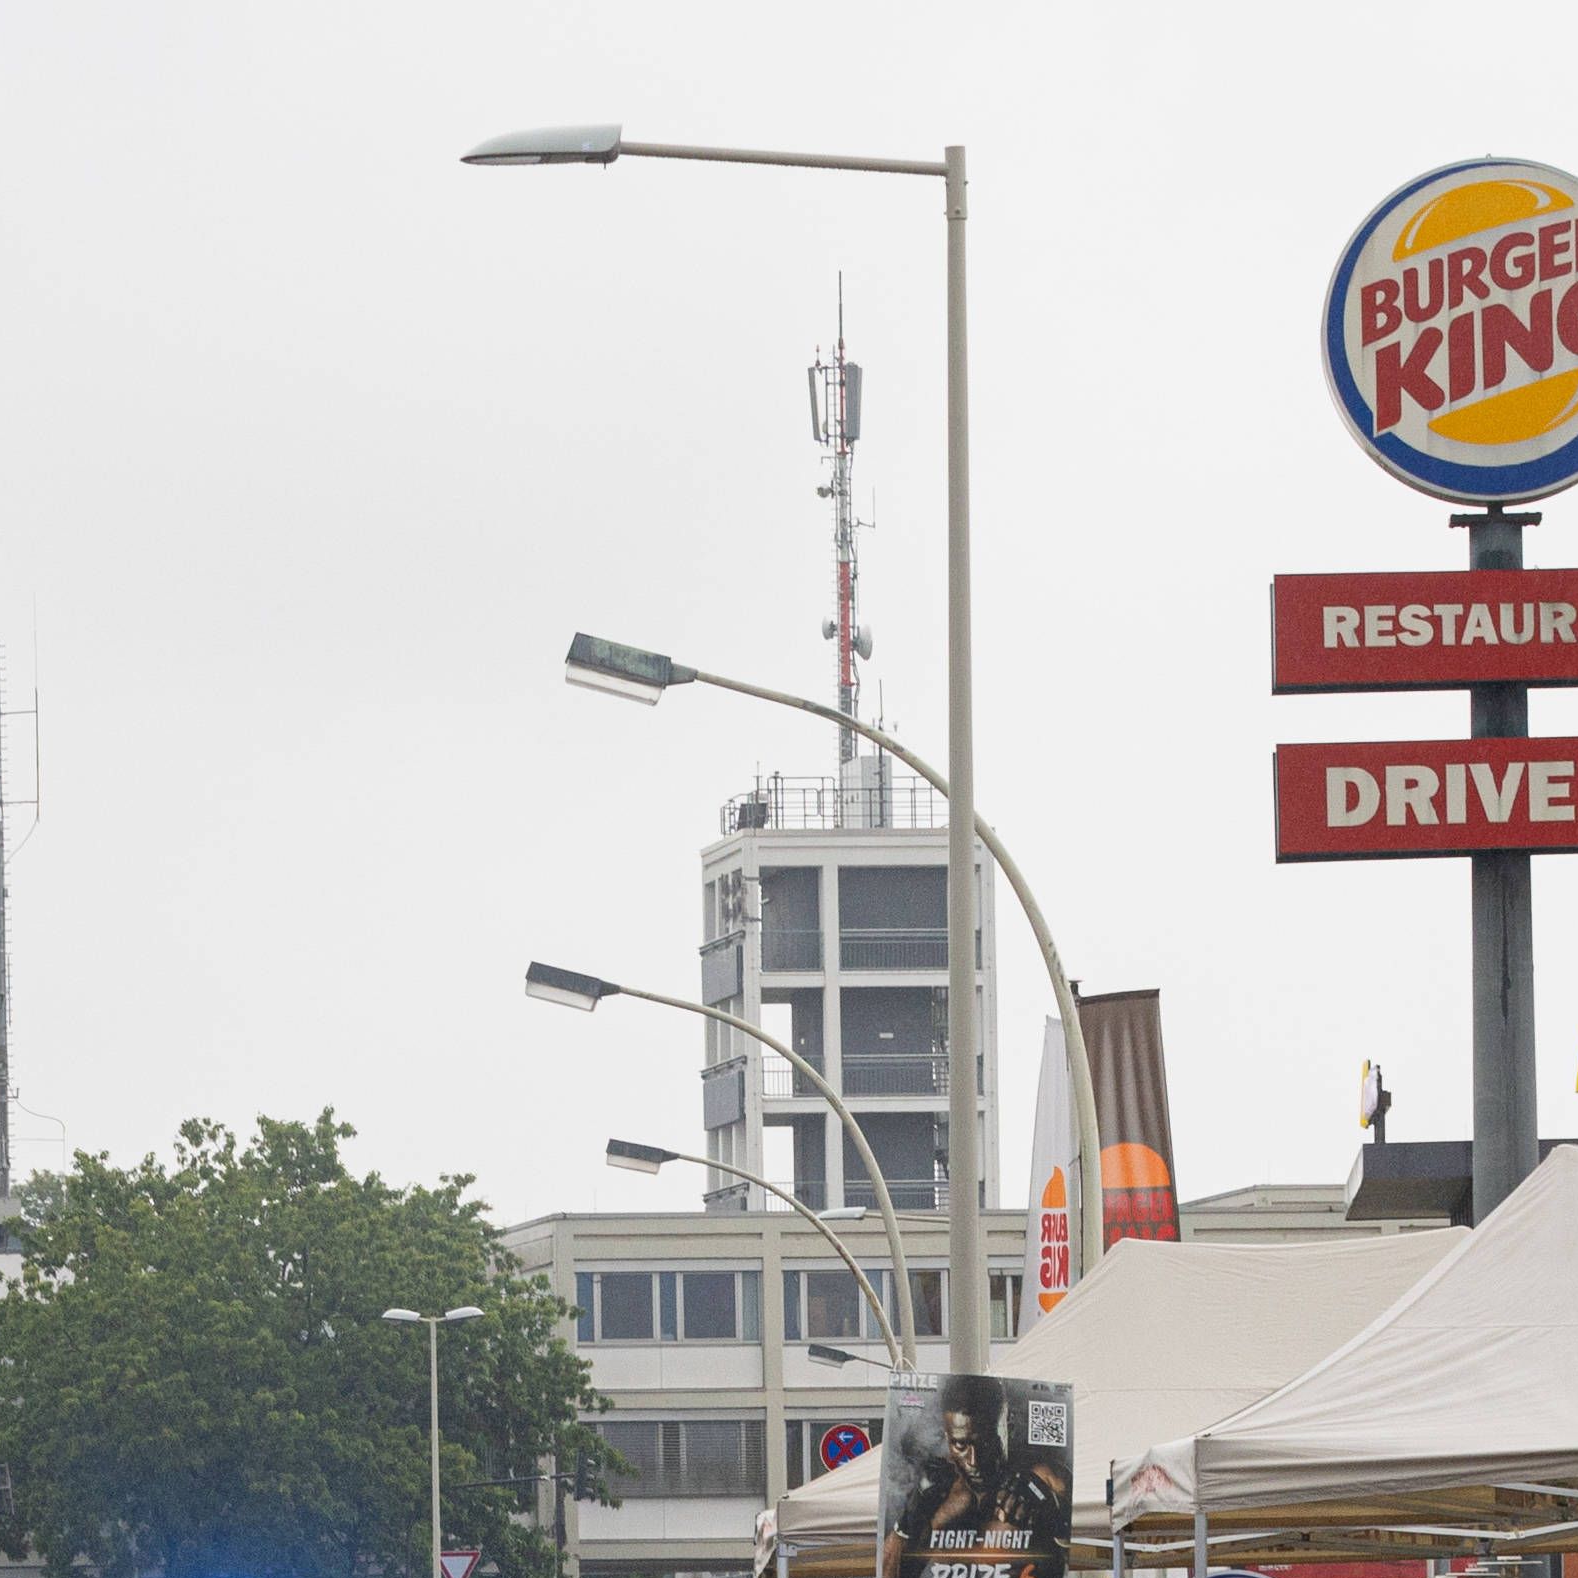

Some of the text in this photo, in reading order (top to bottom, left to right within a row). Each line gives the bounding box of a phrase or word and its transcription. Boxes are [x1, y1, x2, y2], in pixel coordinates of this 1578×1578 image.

[1326, 761, 1576, 827] DRIVE
[889, 1373, 938, 1388] PRIZE
[930, 1530, 1033, 1549] FIGHT-NIGHT
